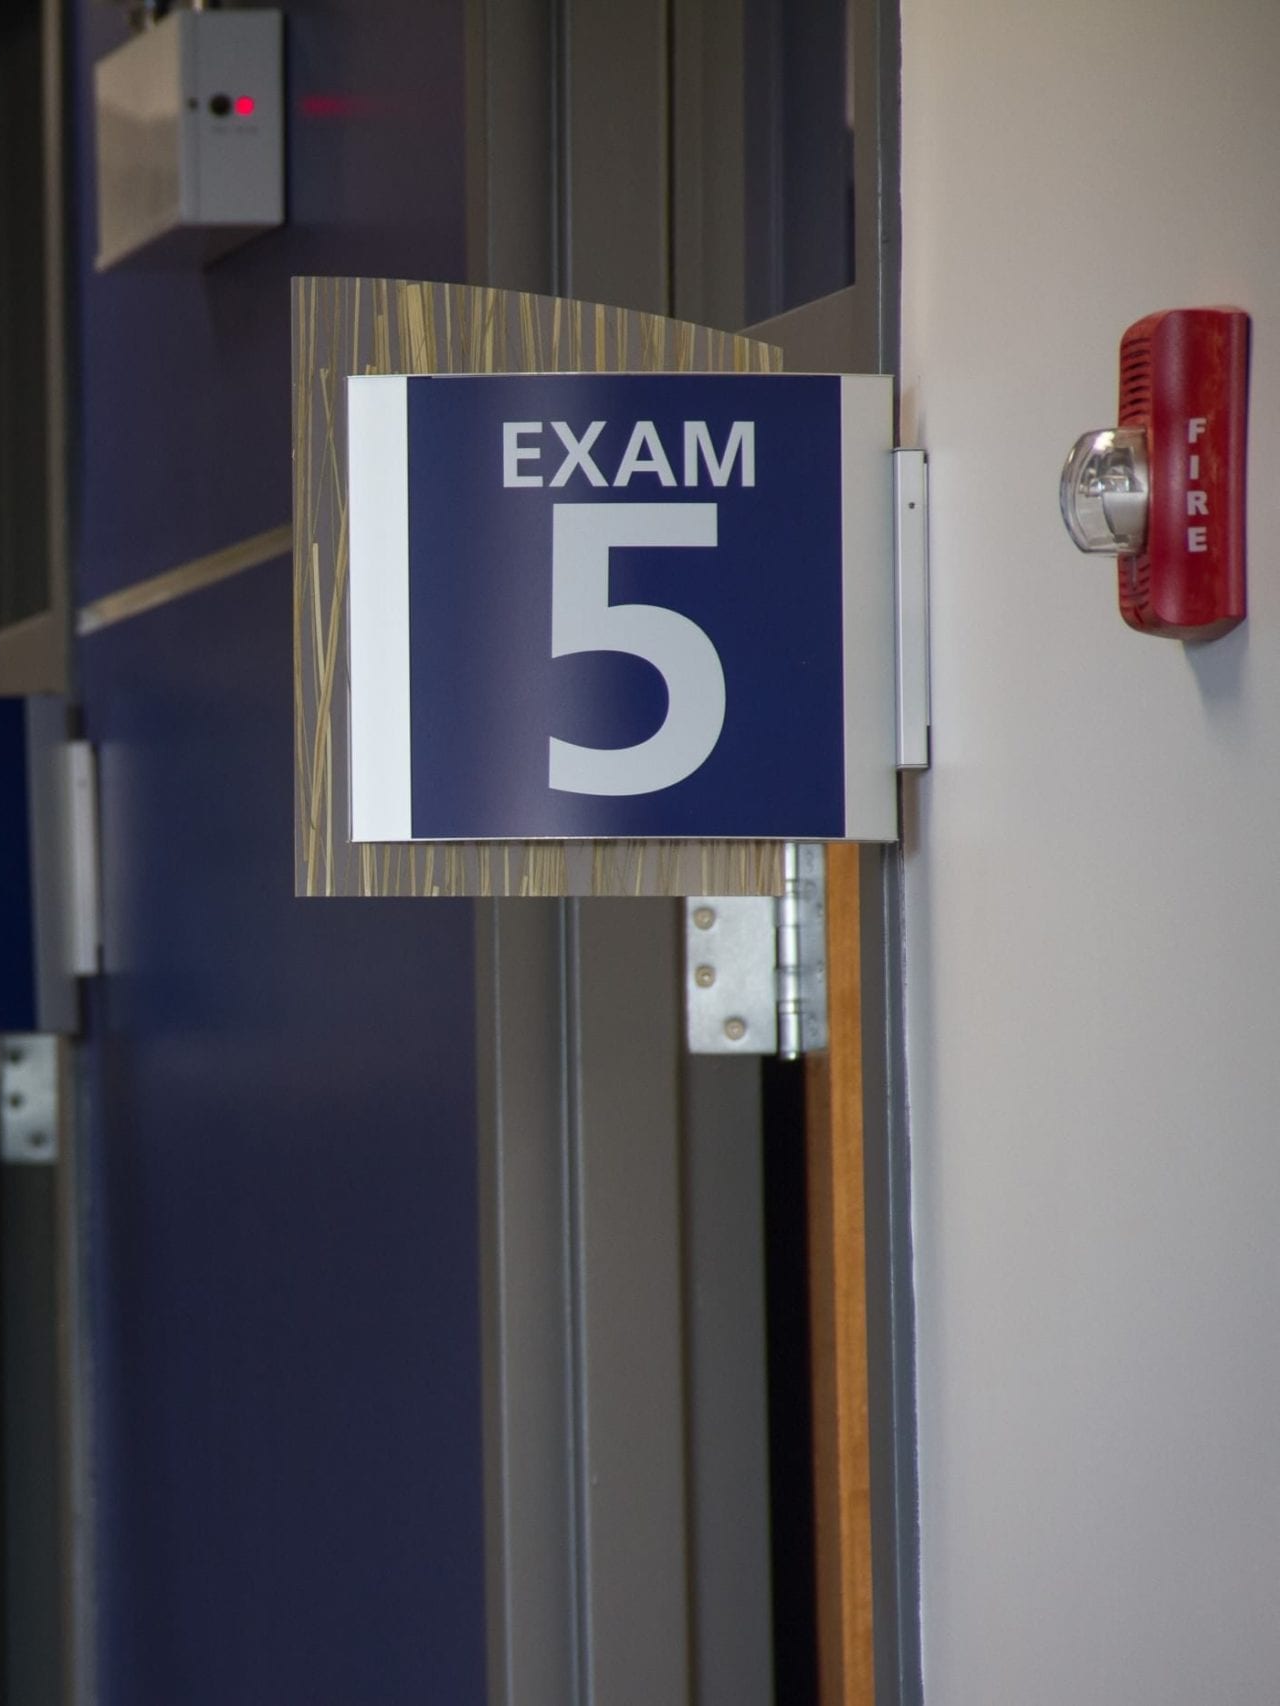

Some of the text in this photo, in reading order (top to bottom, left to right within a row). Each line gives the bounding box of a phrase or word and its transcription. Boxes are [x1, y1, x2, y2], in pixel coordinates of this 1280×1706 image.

[502, 421, 756, 488] EXAM
[1186, 417, 1209, 553] FIRE
[549, 502, 726, 796] 5
